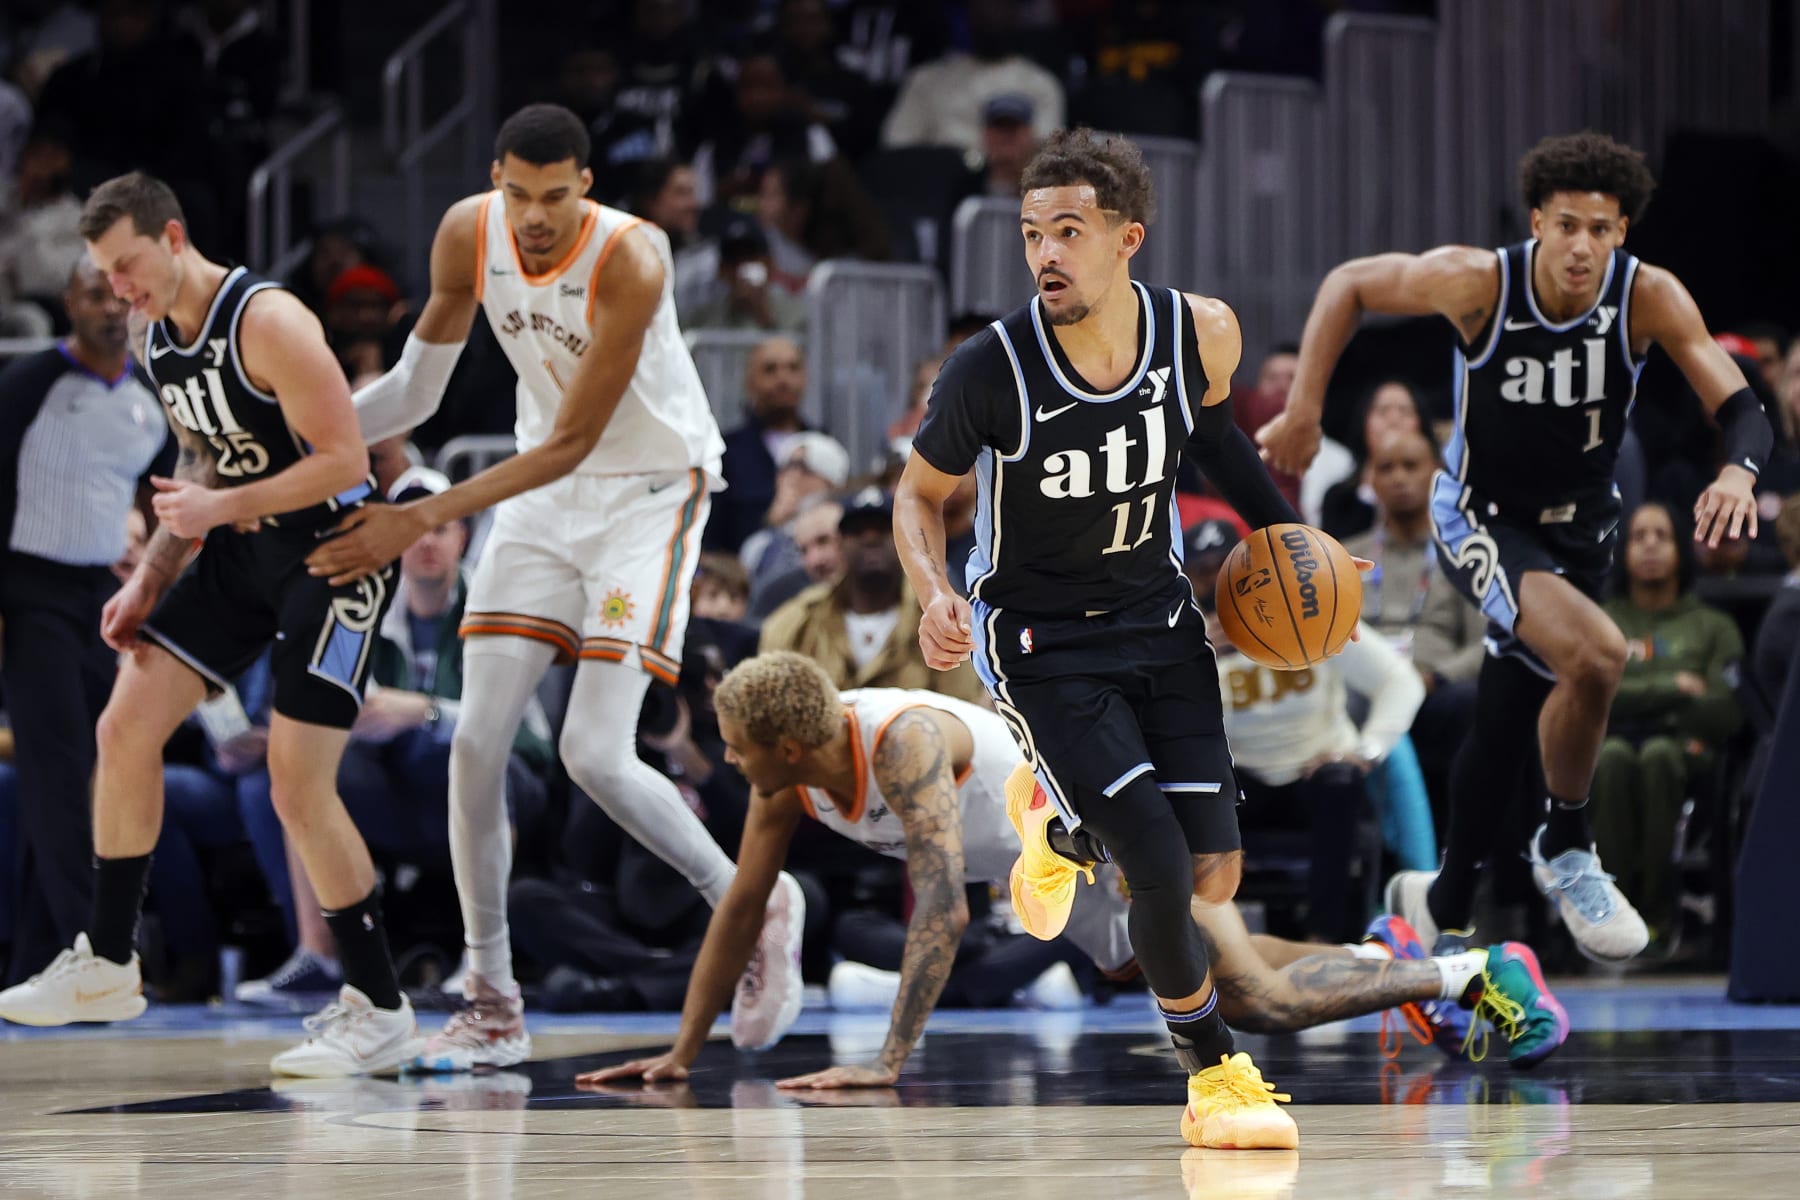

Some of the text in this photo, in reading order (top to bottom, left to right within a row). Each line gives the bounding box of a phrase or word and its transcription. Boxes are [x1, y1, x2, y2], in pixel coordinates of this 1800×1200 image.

[161, 368, 246, 436] atl
[1139, 388, 1151, 397] the
[1501, 338, 1607, 407] atl
[208, 432, 270, 477] 25
[1040, 405, 1167, 499] atl
[1583, 408, 1603, 452] 1
[1102, 492, 1157, 555] 11
[1280, 529, 1320, 620] Wilson
